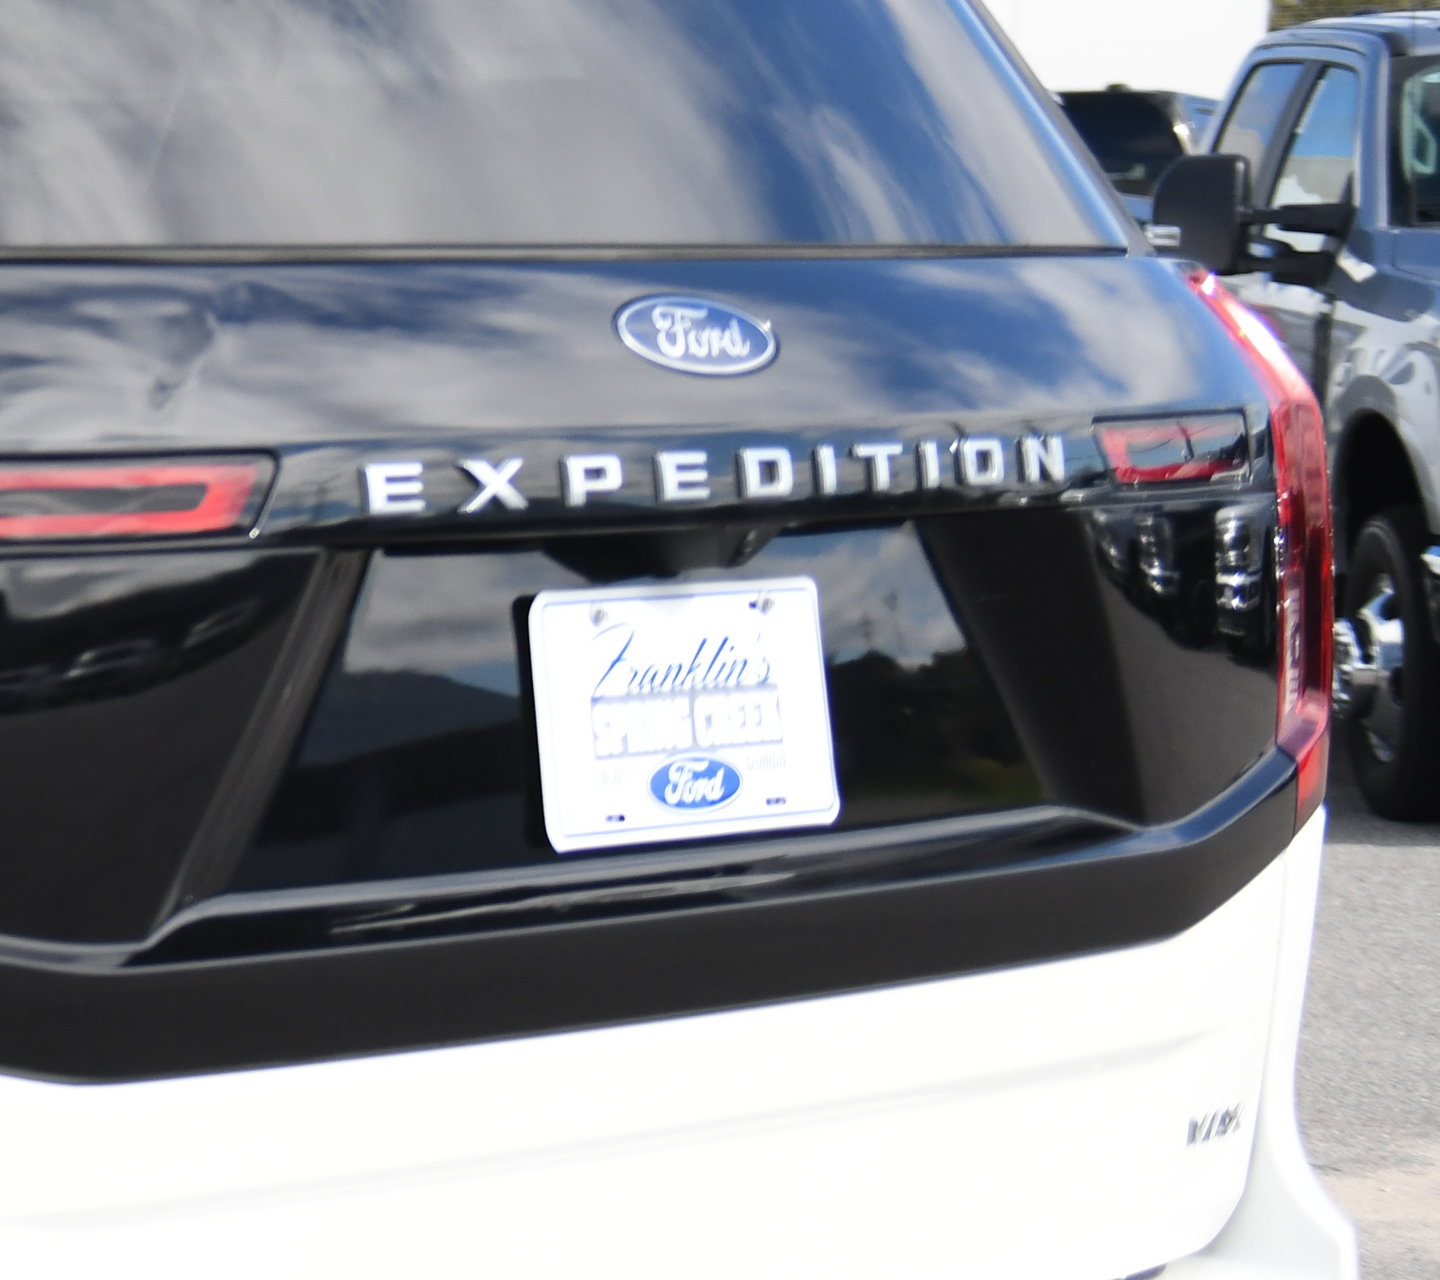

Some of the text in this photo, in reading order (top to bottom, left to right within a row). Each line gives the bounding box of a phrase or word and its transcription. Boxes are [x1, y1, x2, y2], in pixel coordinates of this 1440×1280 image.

[651, 305, 750, 359] Ford
[360, 436, 1066, 515] EXPEDITION
[664, 759, 725, 806] Ford
